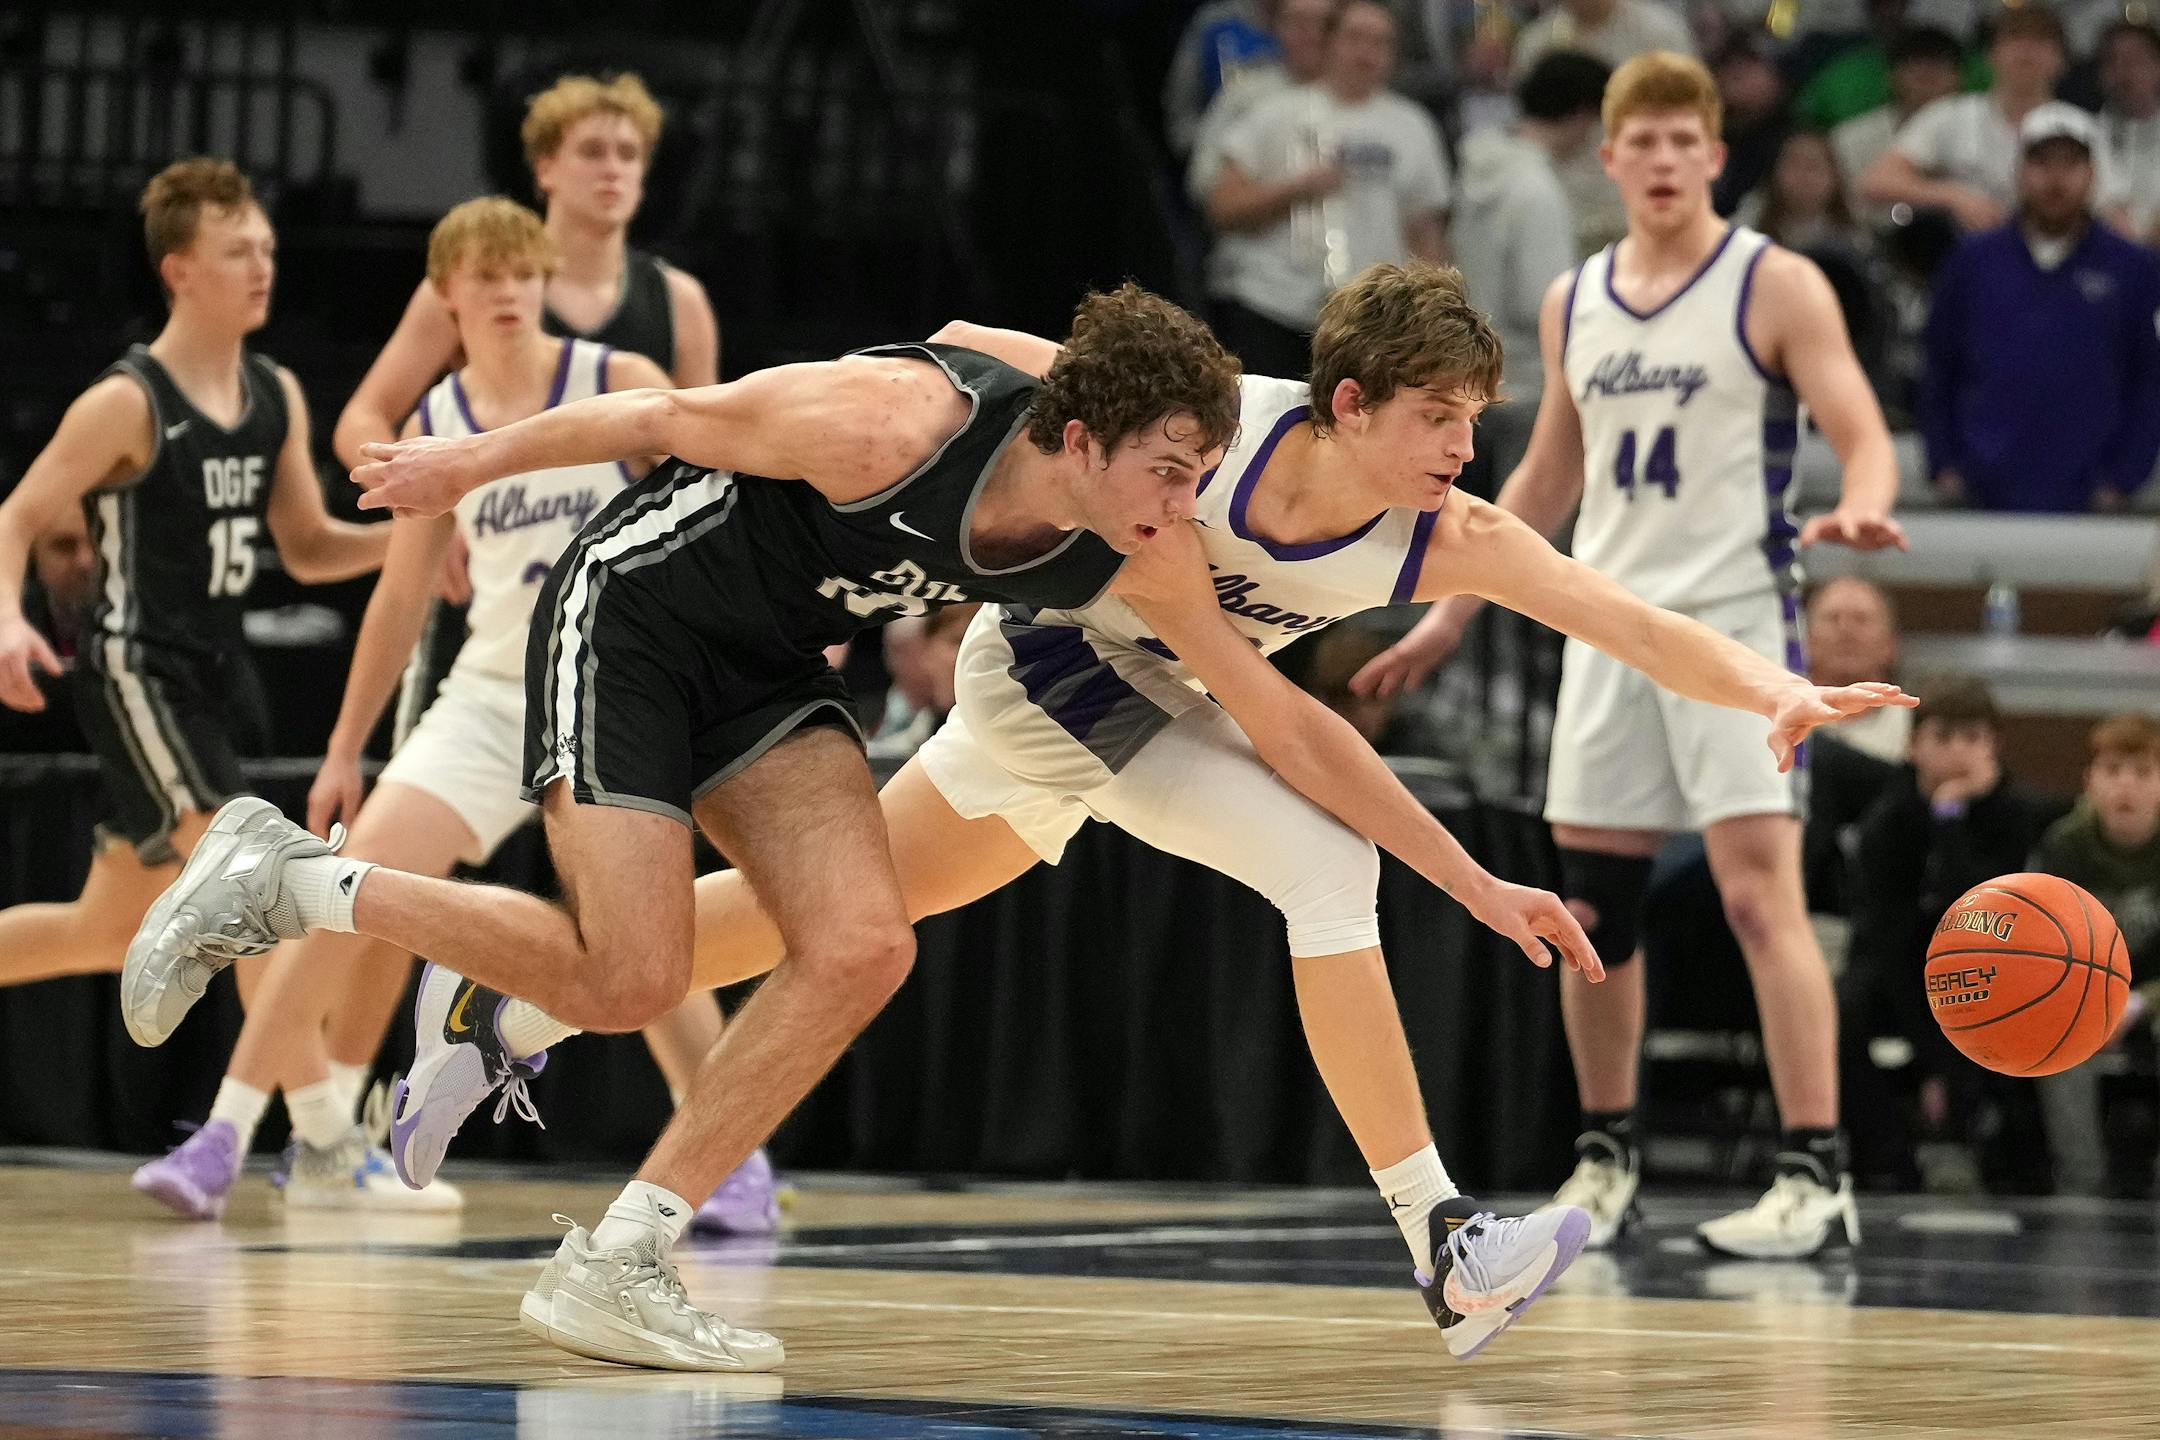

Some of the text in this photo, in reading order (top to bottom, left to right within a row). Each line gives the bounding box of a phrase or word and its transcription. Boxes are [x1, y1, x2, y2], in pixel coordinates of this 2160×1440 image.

[1579, 352, 1708, 406] Albany
[203, 456, 265, 508] DGF
[474, 486, 599, 537] Albany
[208, 516, 258, 597] 15
[1208, 562, 1341, 635] lbany
[1935, 909, 2018, 942] ALDING
